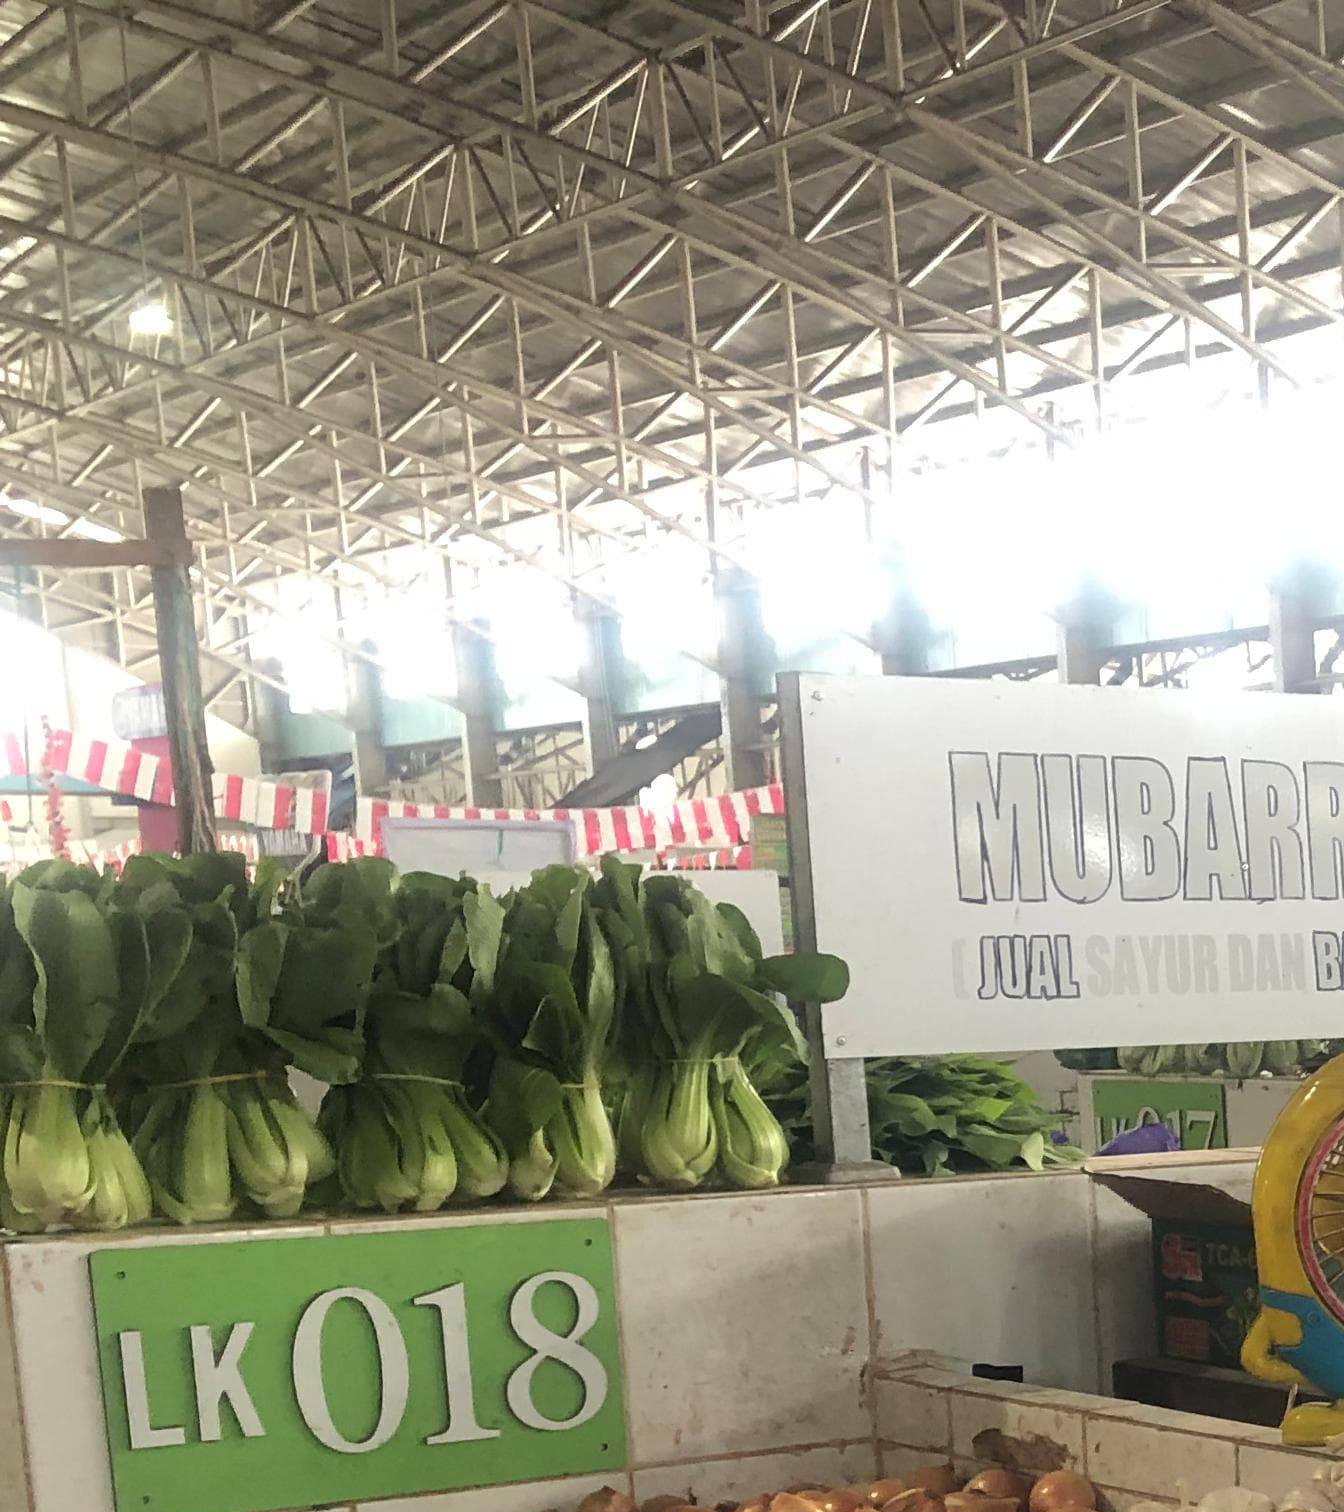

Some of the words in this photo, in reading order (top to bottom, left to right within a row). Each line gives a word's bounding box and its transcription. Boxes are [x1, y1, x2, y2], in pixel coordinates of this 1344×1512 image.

[1085, 933, 1219, 995] SAYUR
[1229, 931, 1306, 993] DAN
[119, 1322, 267, 1450] LK
[291, 1270, 609, 1454] 018
